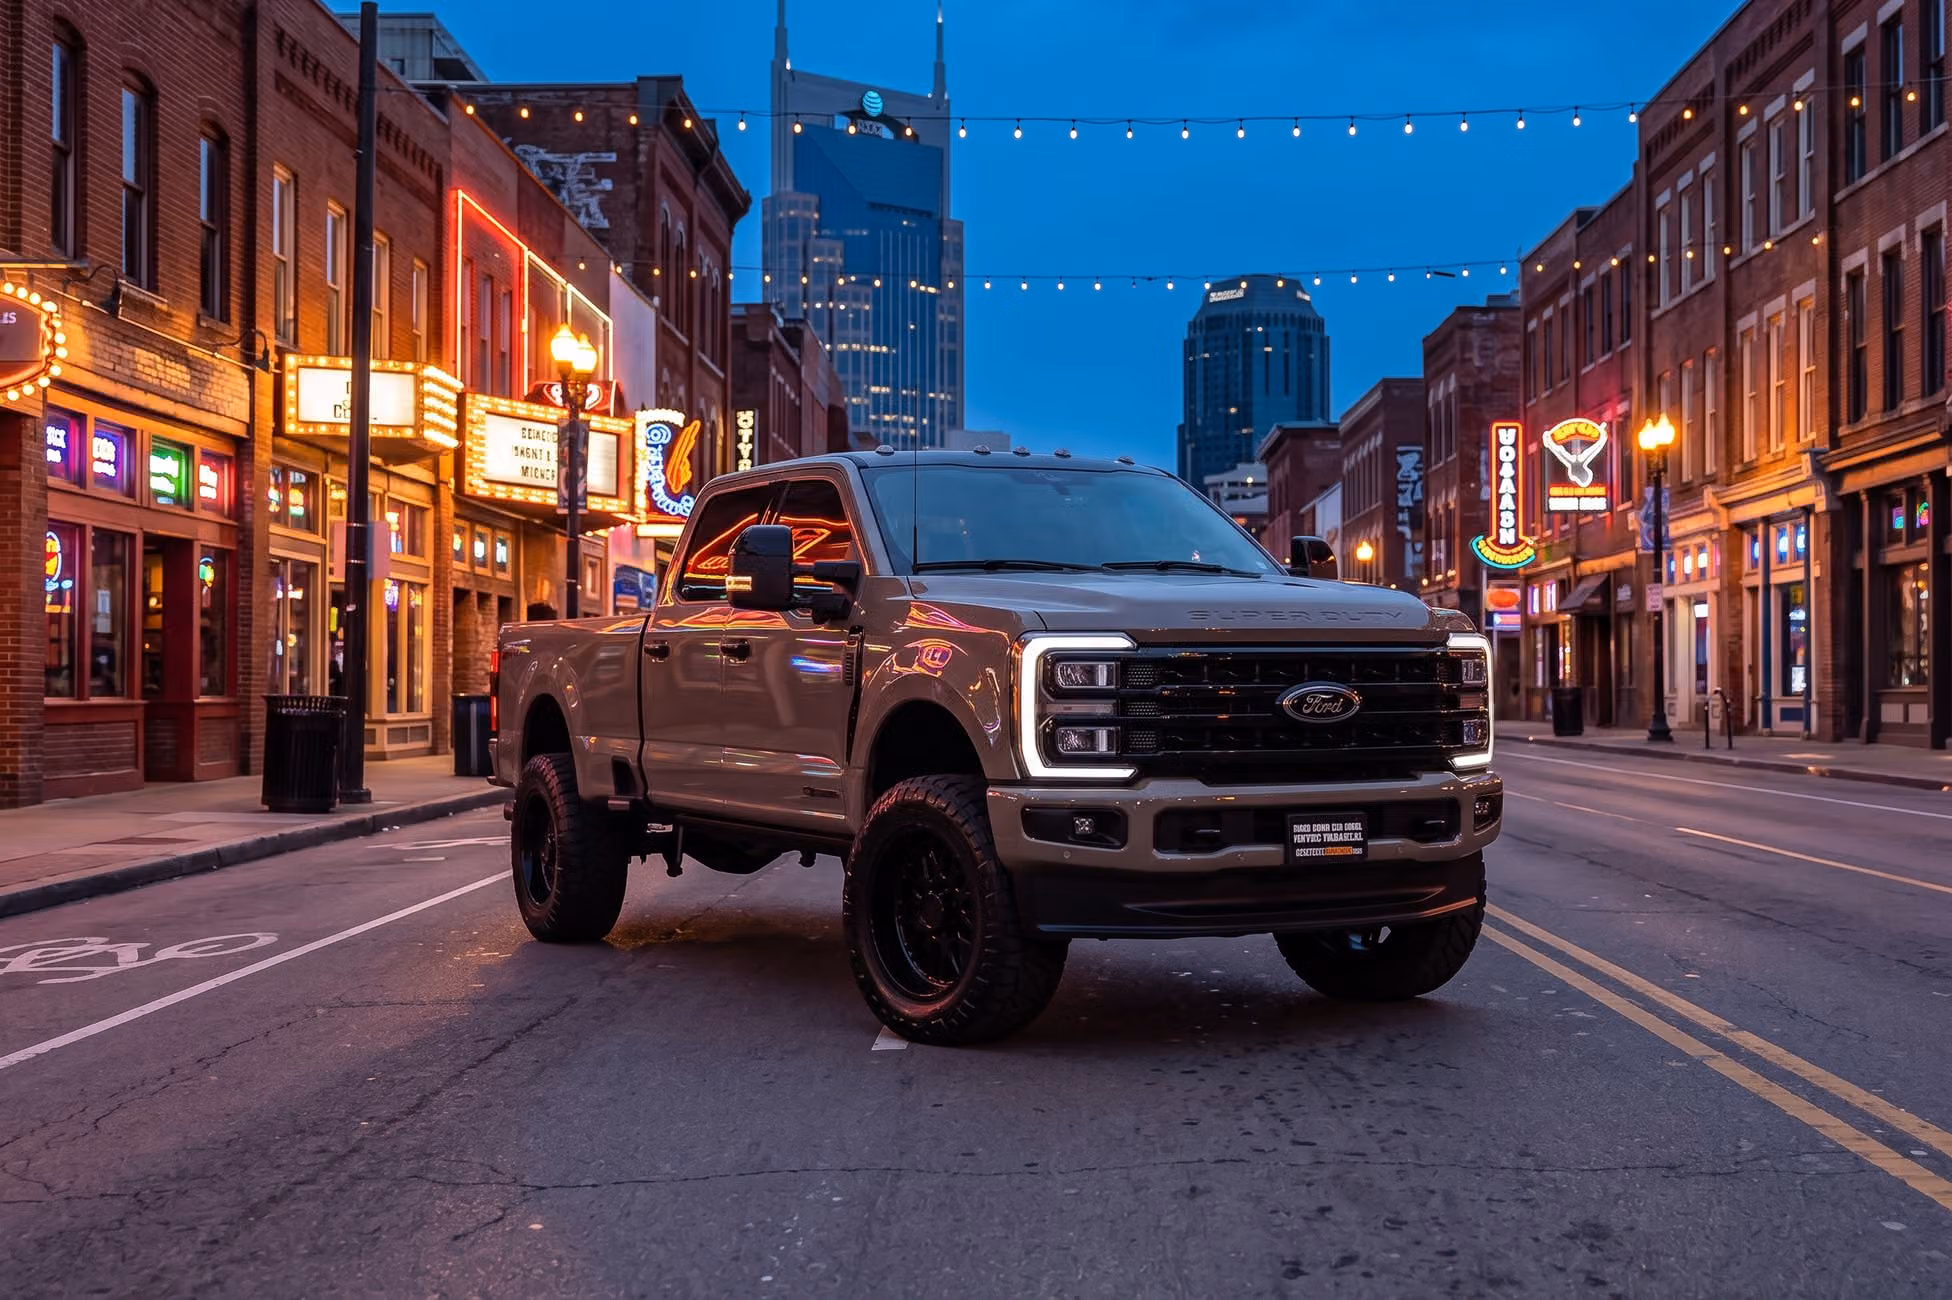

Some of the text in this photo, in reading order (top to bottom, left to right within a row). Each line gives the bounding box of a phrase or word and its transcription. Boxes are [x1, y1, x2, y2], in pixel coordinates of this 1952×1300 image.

[1187, 610, 1403, 621] SUPER DUTY
[1302, 693, 1343, 714] Ford
